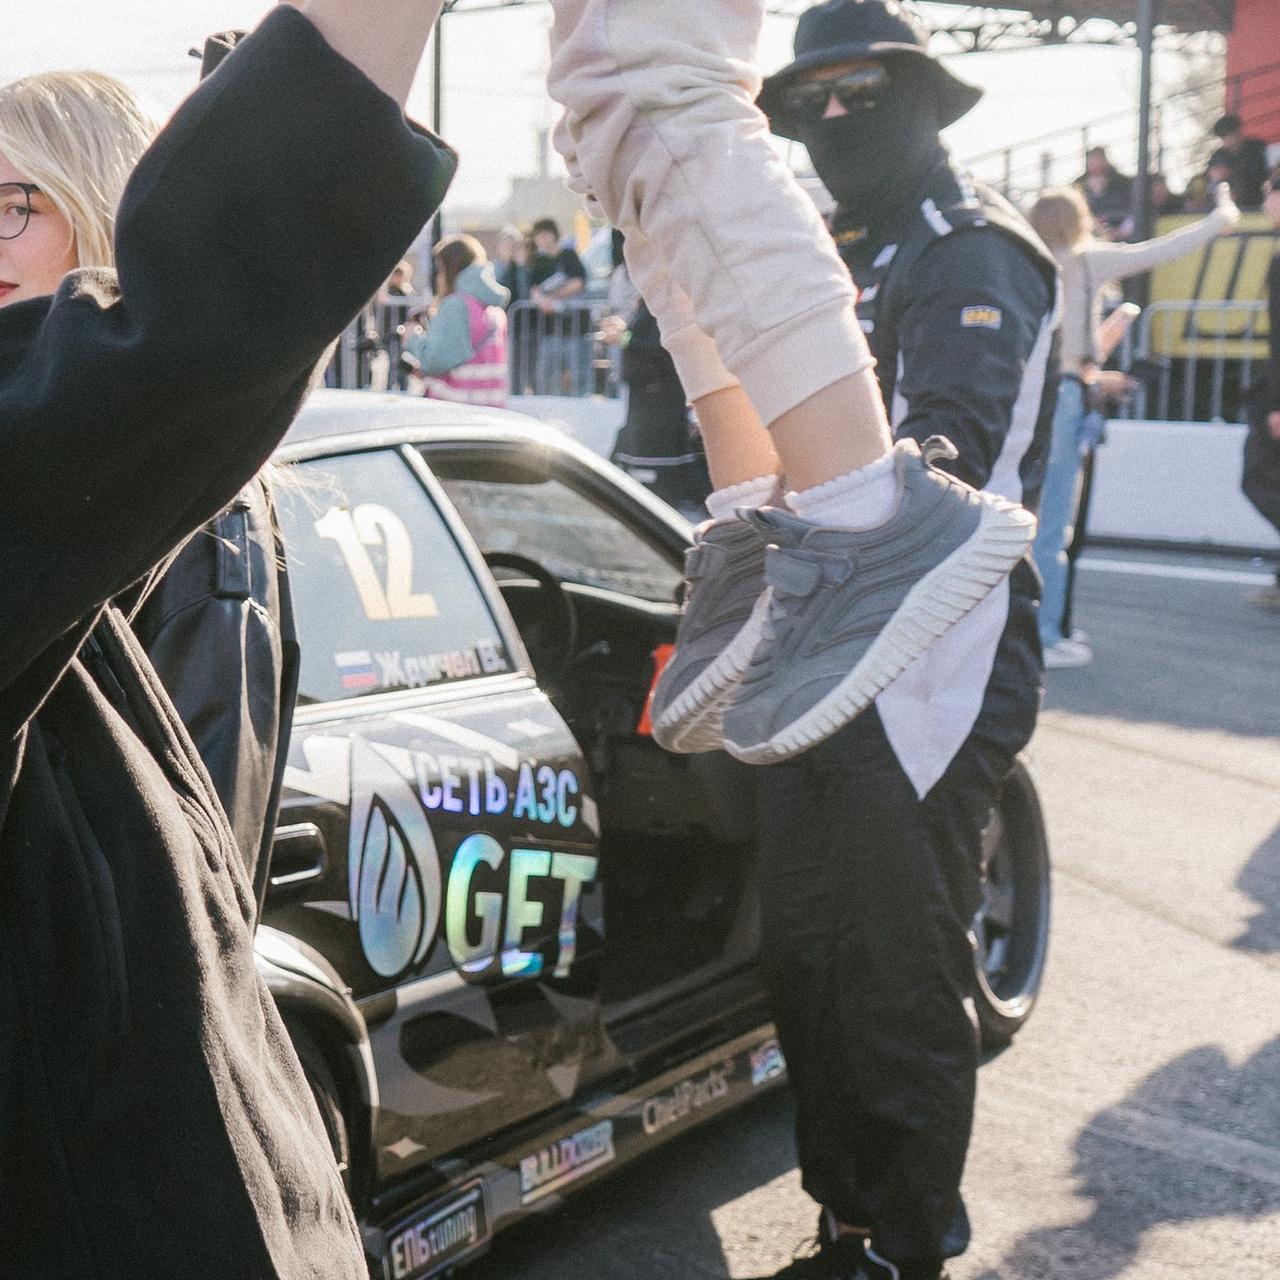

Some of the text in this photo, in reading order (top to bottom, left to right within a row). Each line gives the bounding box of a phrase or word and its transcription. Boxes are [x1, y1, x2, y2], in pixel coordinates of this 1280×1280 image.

[313, 502, 439, 621] 12
[413, 749, 579, 828] СЕТЬ АЗС
[446, 833, 598, 978] GET
